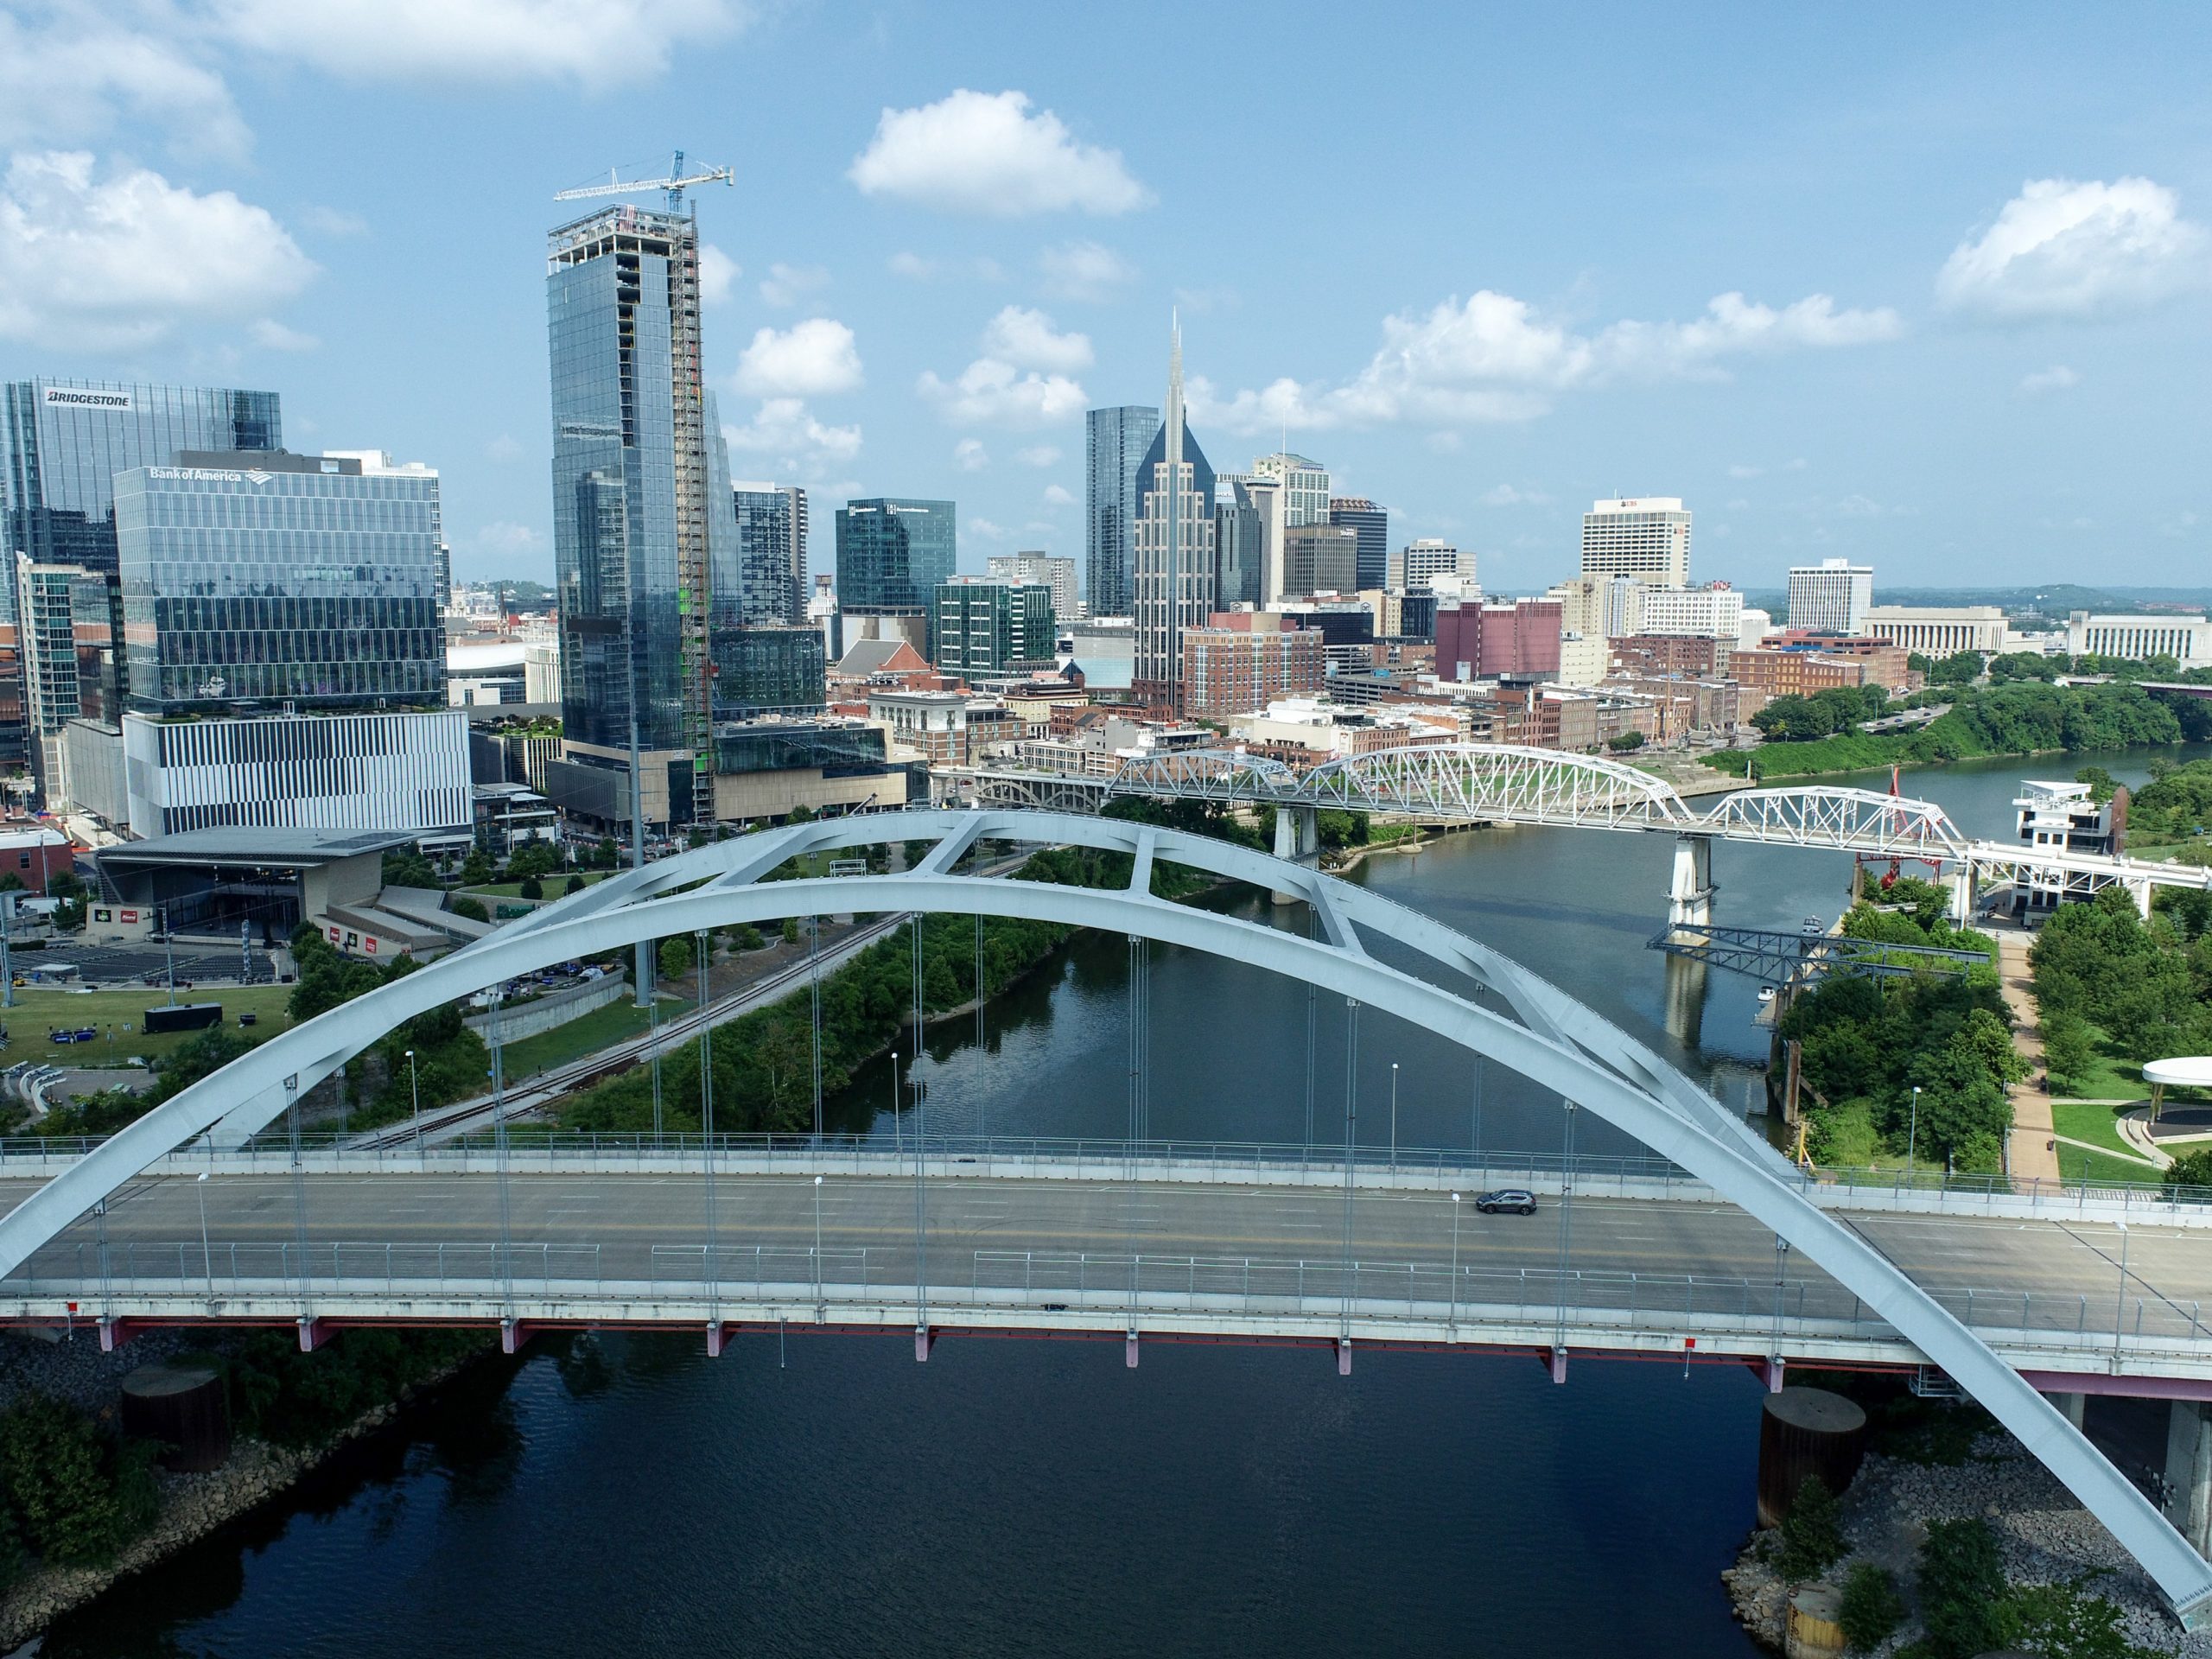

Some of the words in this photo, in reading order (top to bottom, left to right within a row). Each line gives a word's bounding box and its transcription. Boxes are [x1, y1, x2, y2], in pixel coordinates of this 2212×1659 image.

[48, 391, 130, 406] BRIDGESTONE
[149, 467, 181, 480] Bank
[181, 467, 194, 480] of
[194, 469, 242, 482] America
